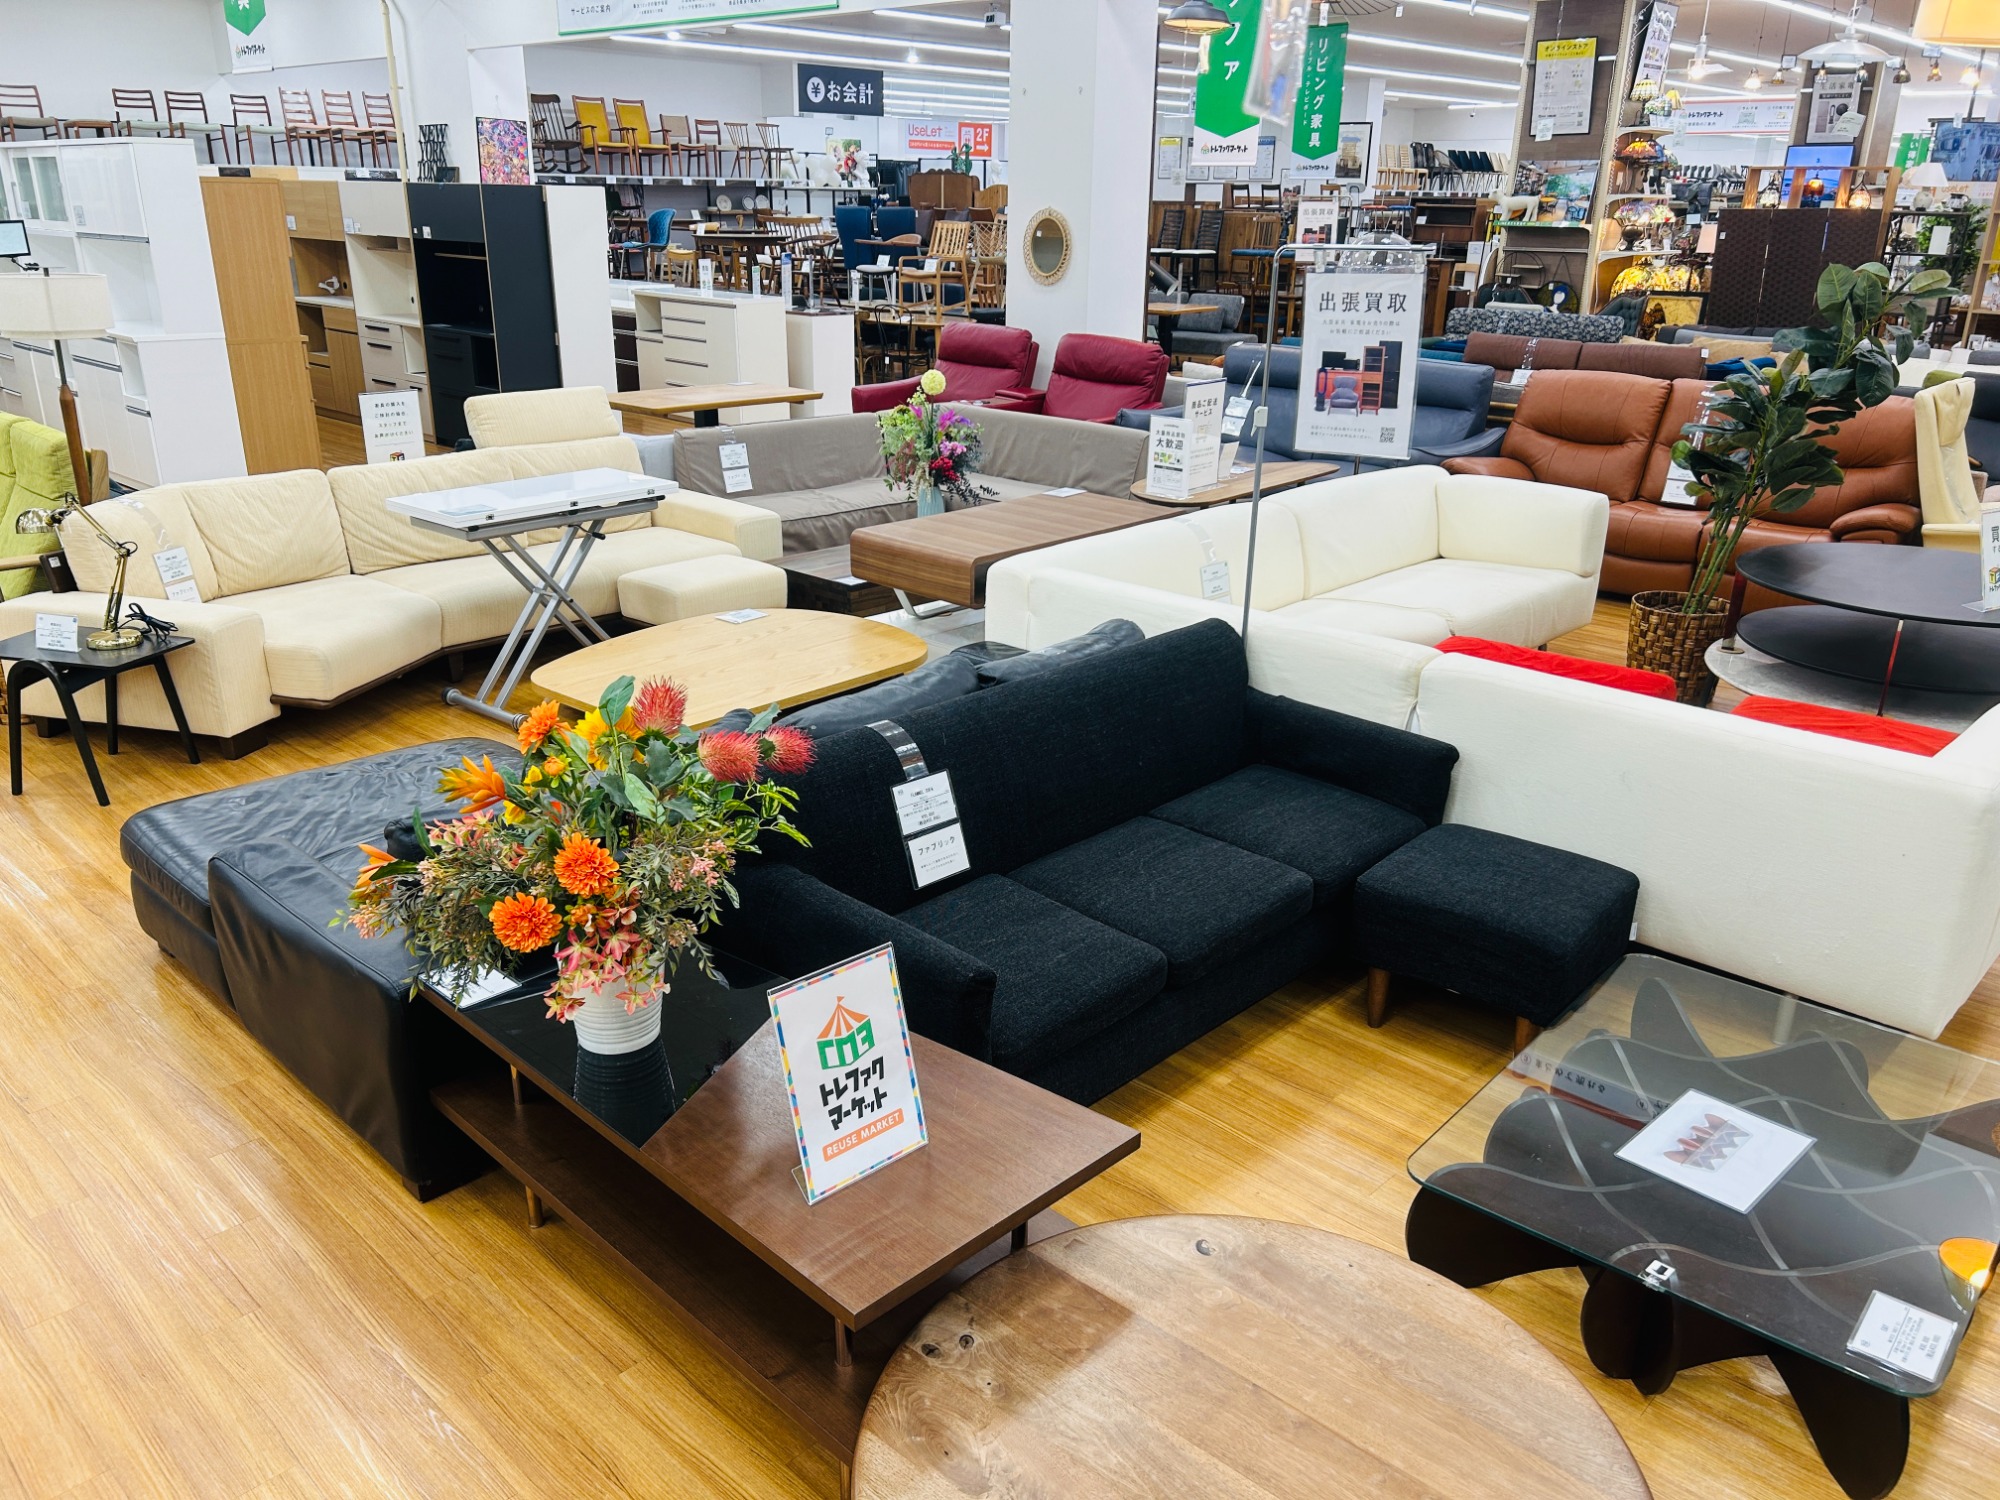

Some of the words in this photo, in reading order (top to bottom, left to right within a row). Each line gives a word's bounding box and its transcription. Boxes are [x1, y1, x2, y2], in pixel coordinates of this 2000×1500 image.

[827, 80, 874, 105] お会計
[1309, 38, 1329, 148] リビング家具
[418, 123, 448, 141] NEW
[908, 123, 943, 138] UseLet
[976, 127, 990, 142] 2F
[418, 140, 447, 161] YORK
[1319, 291, 1407, 314] 出張買取
[1195, 408, 1213, 418] サービス
[1156, 437, 1184, 451] 大歓迎
[918, 835, 956, 856] ファブリック
[819, 1055, 885, 1108] トレファク
[828, 1085, 888, 1132] マーケット
[826, 1132, 858, 1157] REUSE
[860, 1112, 901, 1140] MARKET
